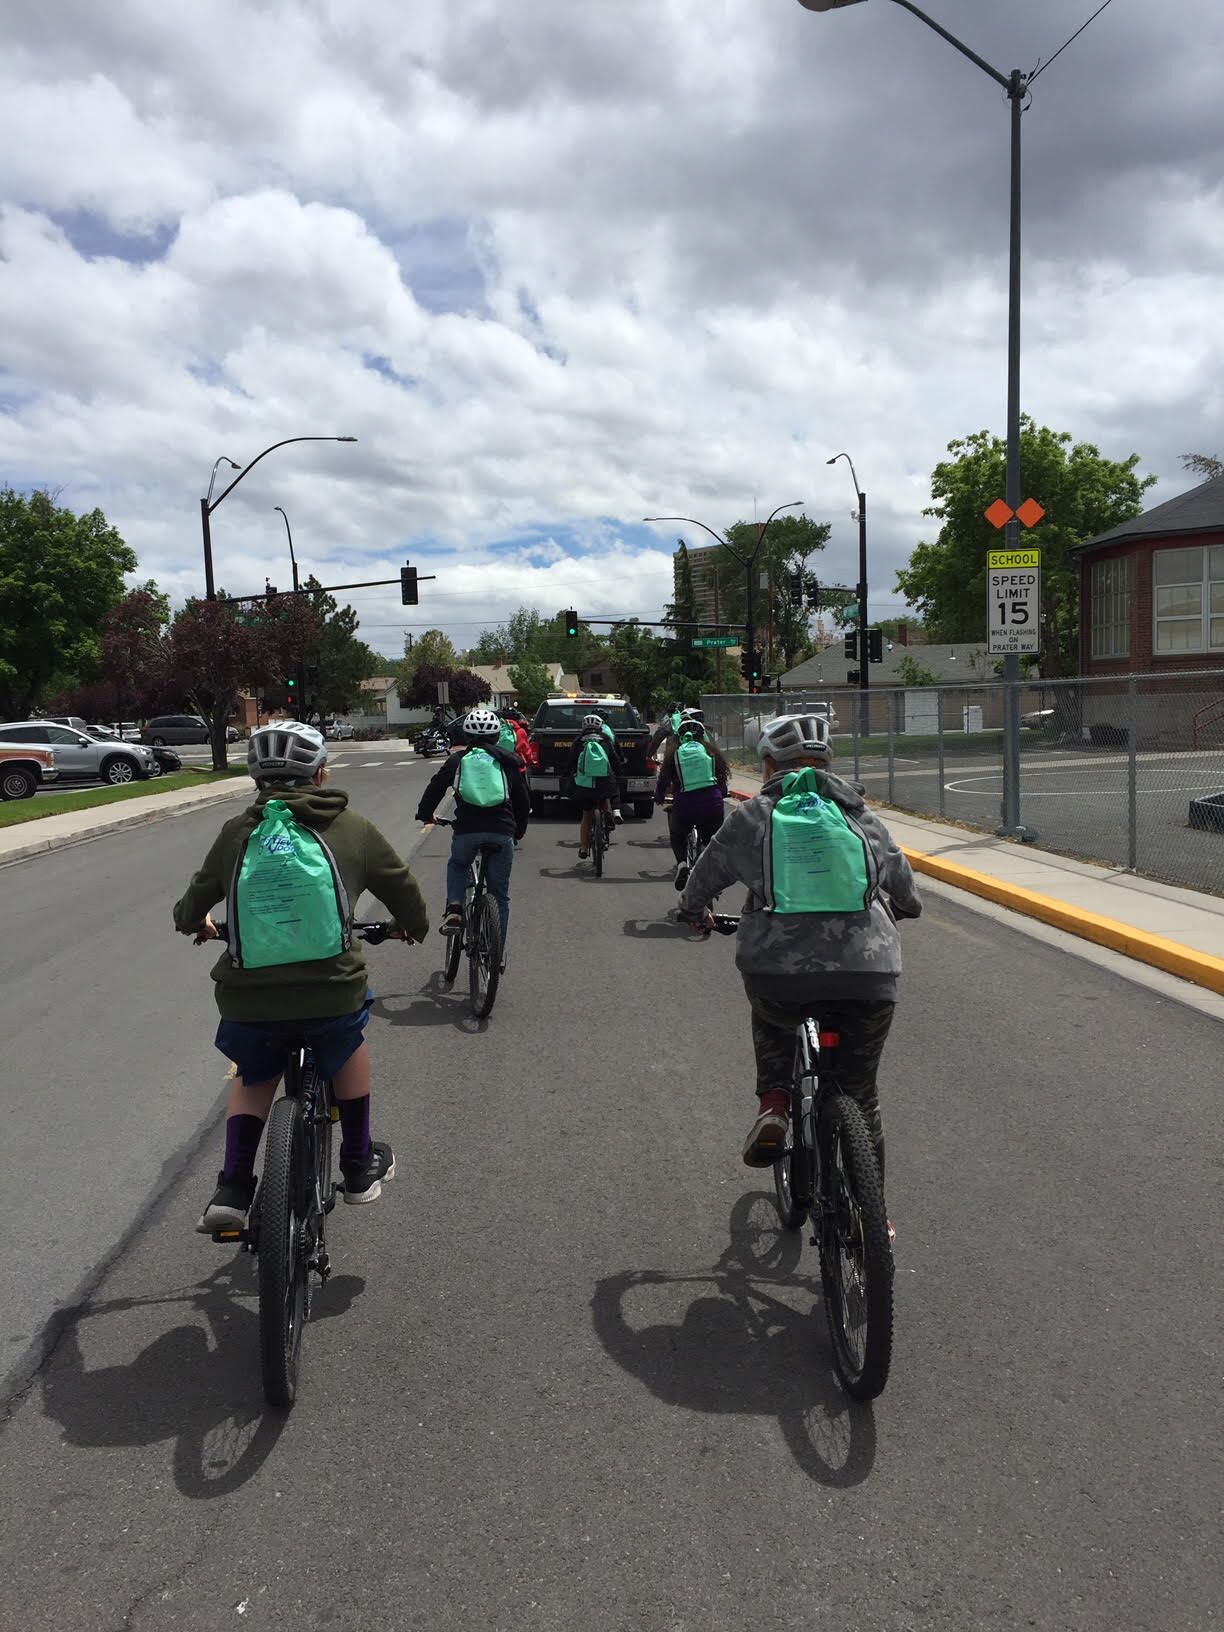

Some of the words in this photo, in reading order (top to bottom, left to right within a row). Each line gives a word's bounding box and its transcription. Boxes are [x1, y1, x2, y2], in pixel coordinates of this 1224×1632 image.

[991, 554, 1037, 565] SCHOOL
[992, 575, 1036, 586] SPEED
[996, 588, 1031, 599] LIMIT
[998, 602, 1029, 625] 15
[991, 629, 1008, 637] WHEN
